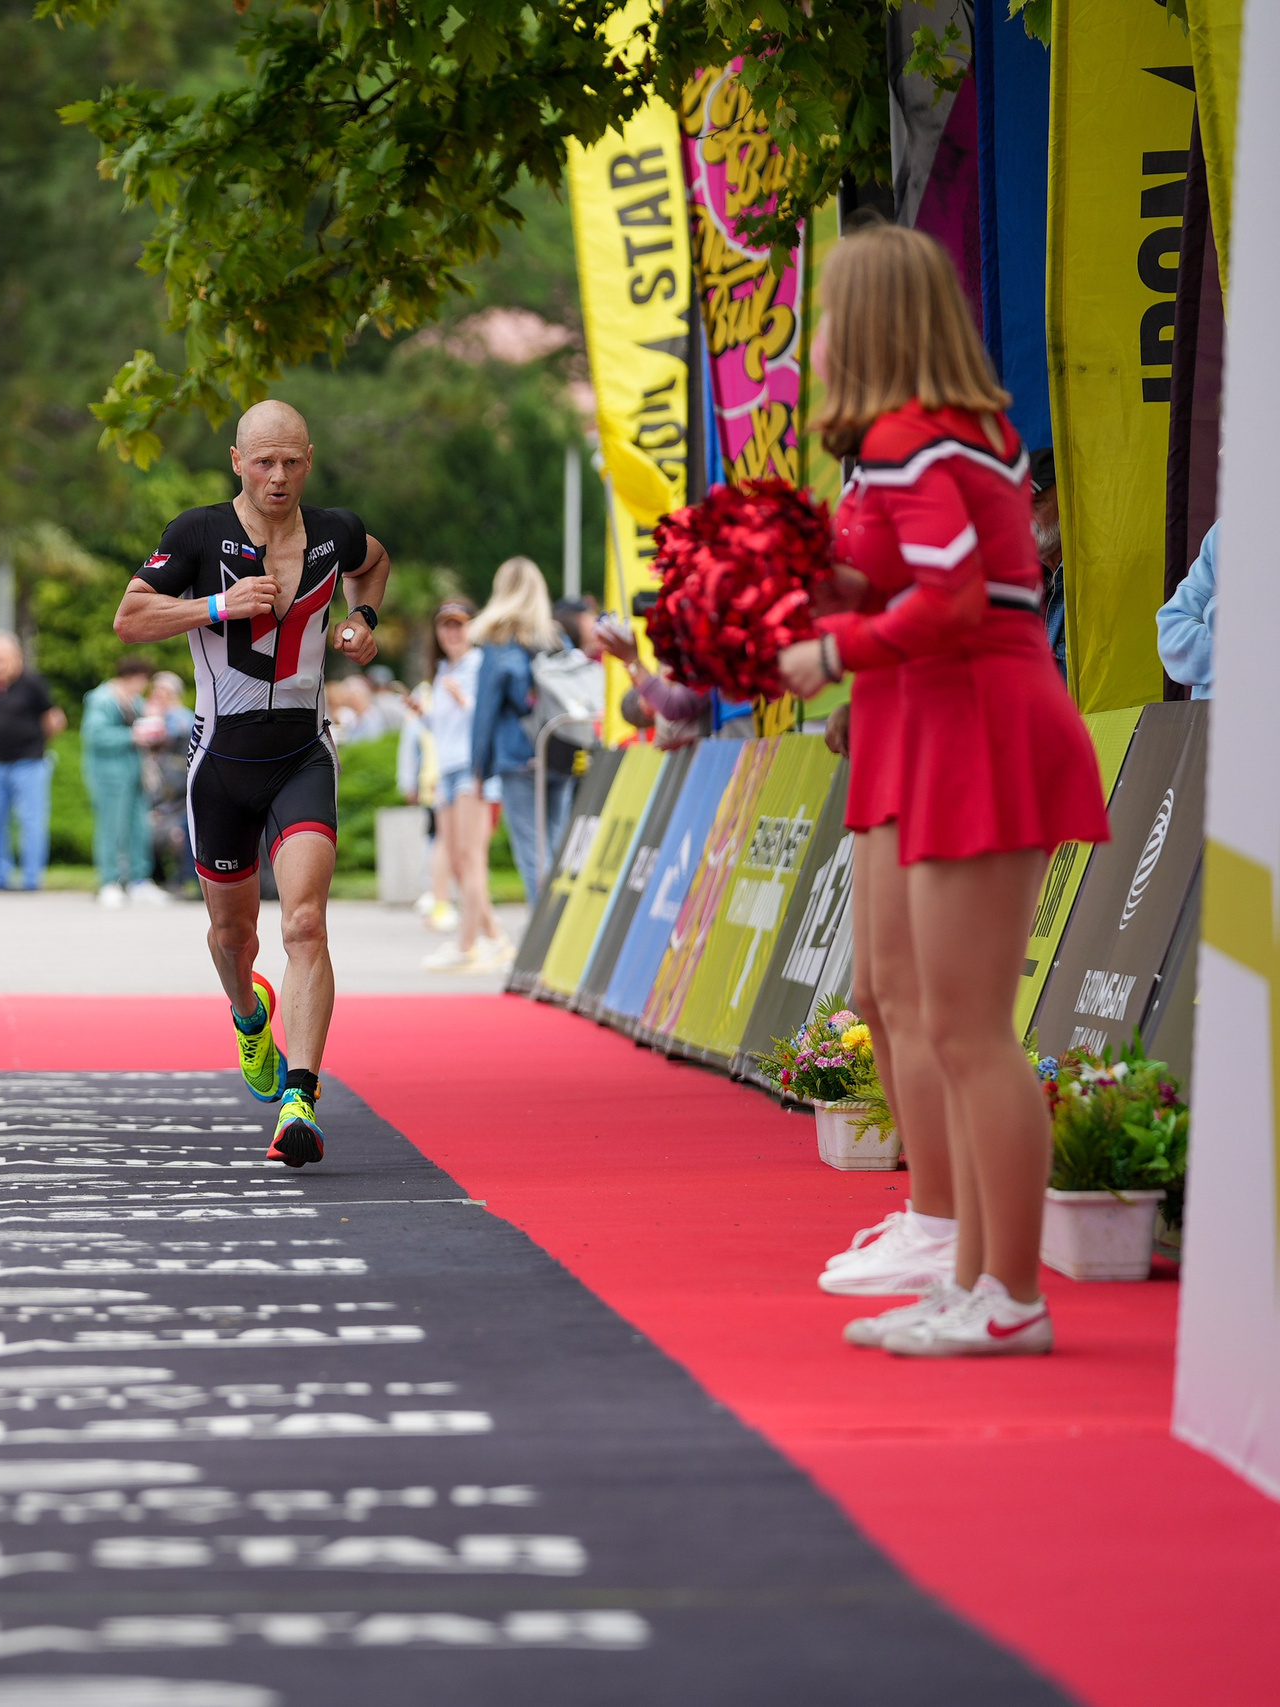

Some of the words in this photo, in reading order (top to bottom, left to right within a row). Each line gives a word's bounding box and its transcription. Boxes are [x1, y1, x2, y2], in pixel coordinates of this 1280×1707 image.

[609, 145, 677, 305] STAR
[1029, 841, 1078, 937] STAR
[51, 1122, 262, 1132] STAR
[55, 1157, 285, 1168] STAR
[48, 1190, 304, 1201] STAR
[49, 1207, 318, 1219] STAR
[61, 1257, 368, 1272] STAR
[75, 1324, 424, 1345] STAR
[84, 1409, 492, 1440] STAR
[93, 1534, 586, 1574] STAR
